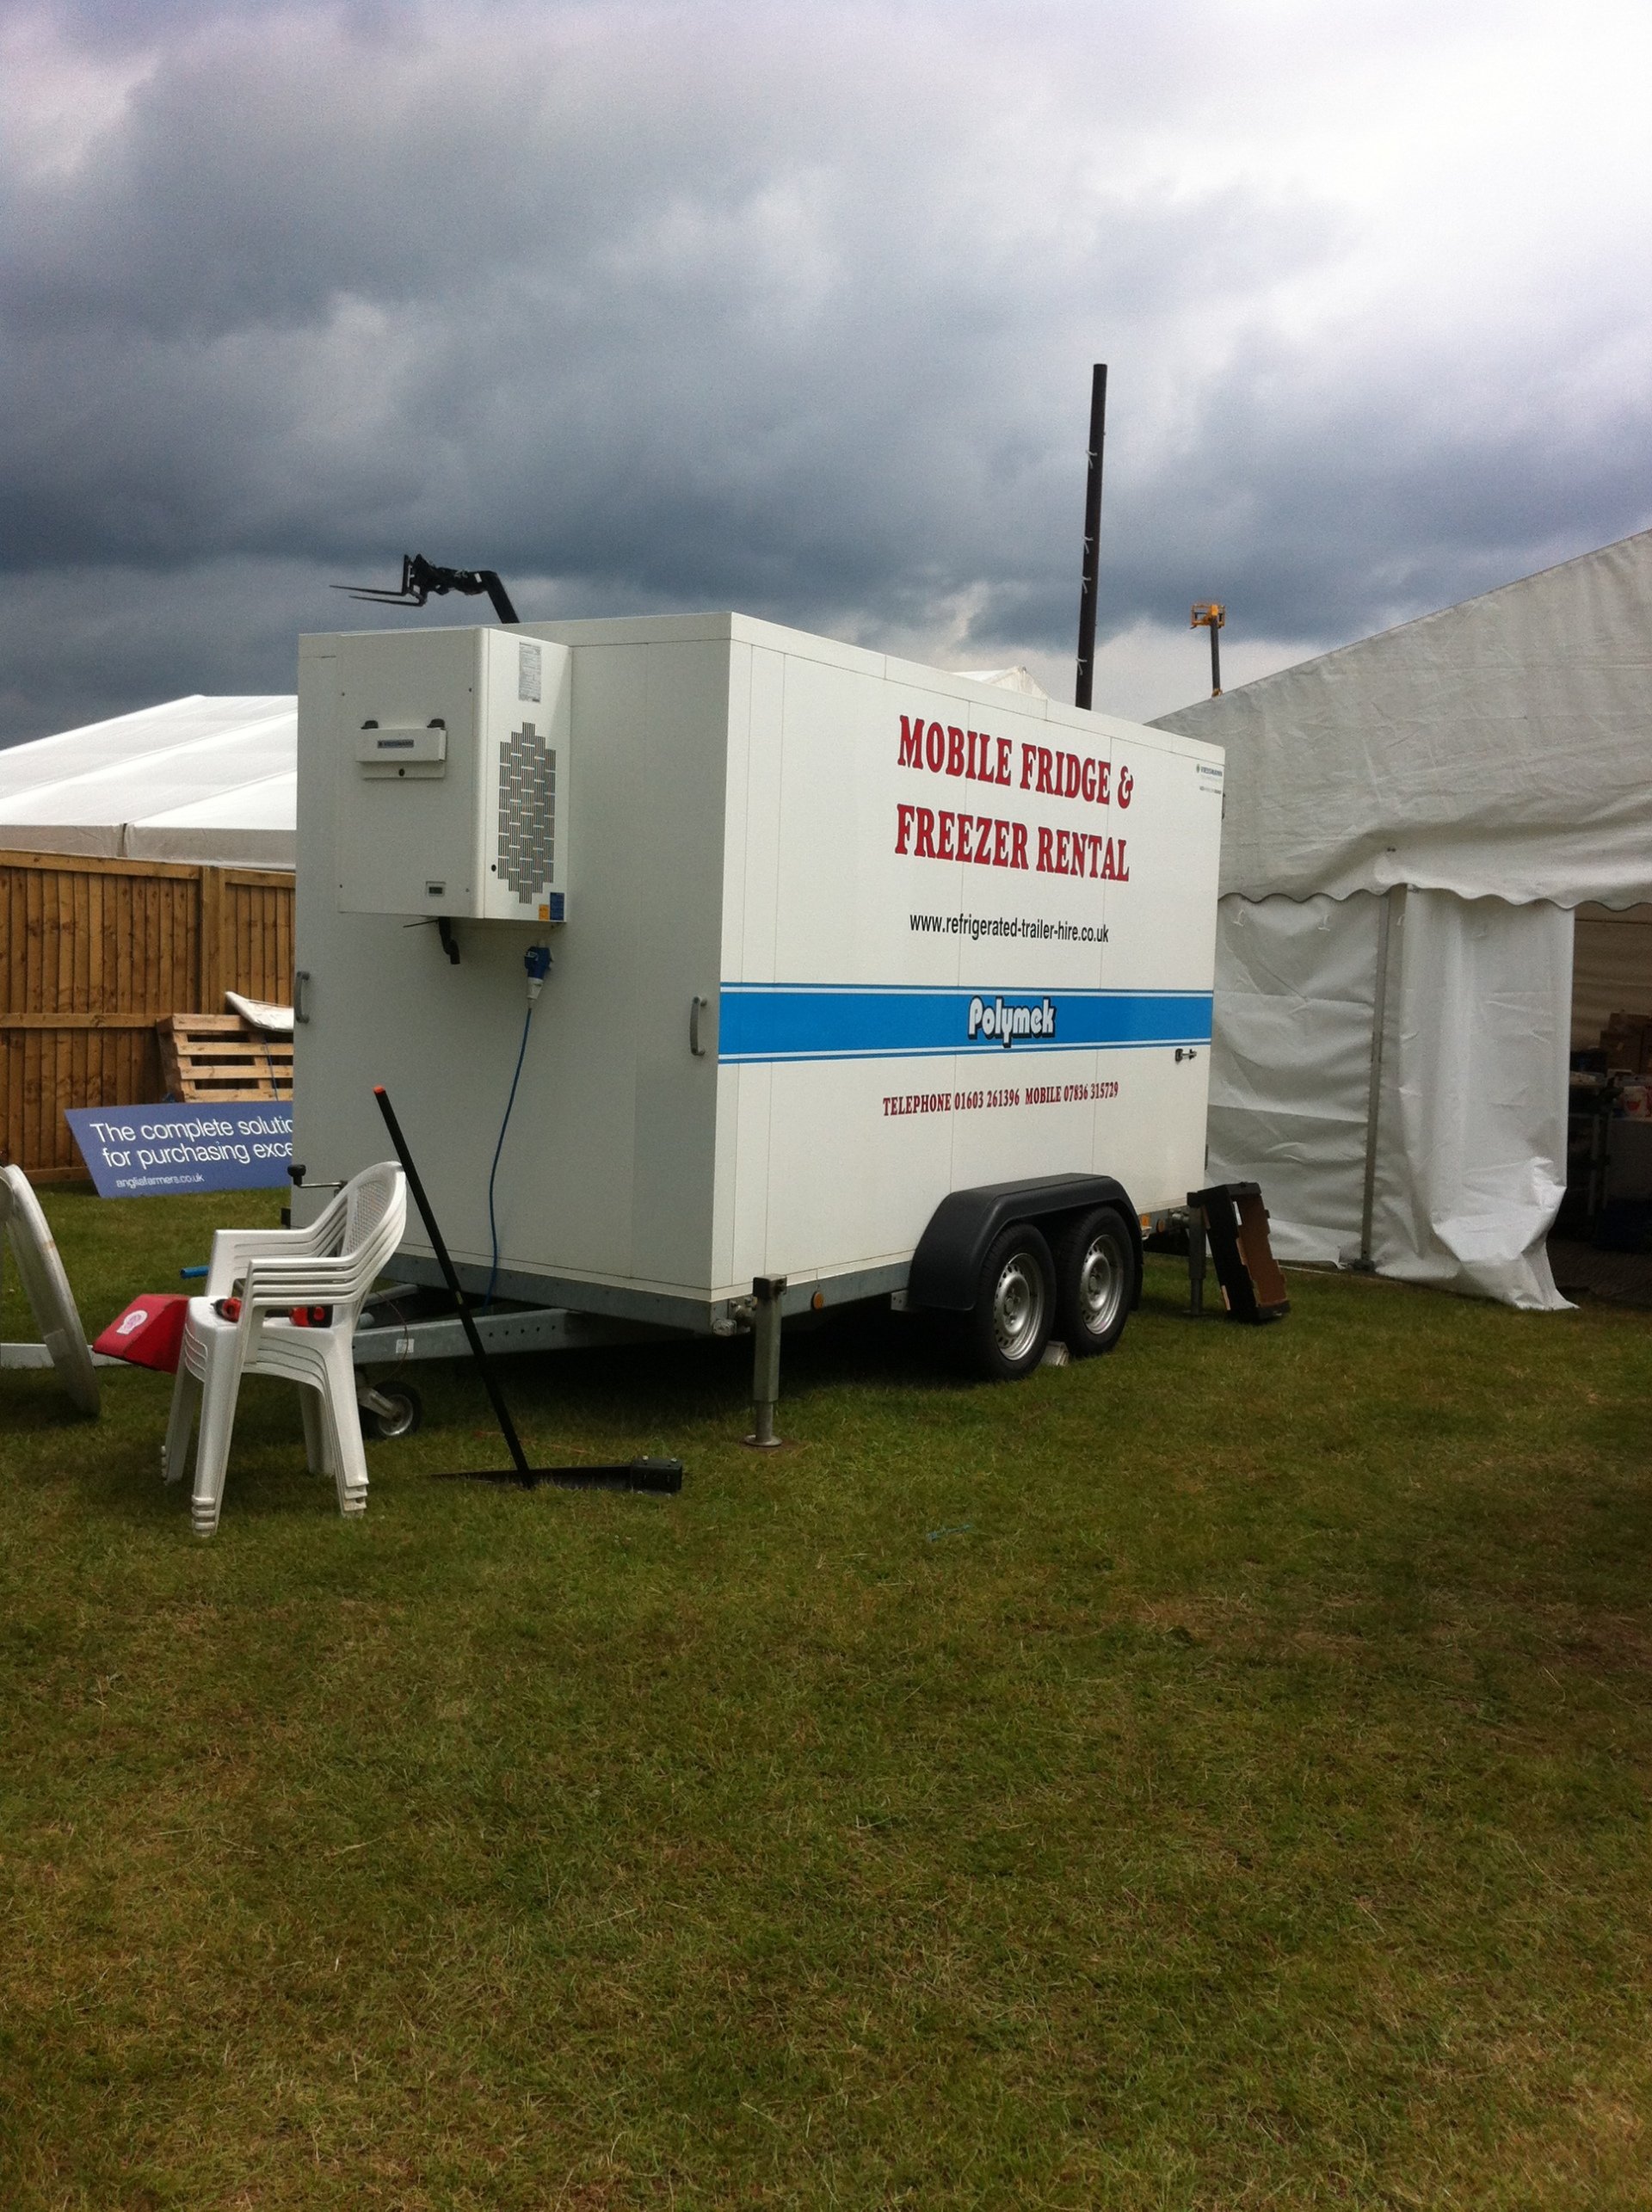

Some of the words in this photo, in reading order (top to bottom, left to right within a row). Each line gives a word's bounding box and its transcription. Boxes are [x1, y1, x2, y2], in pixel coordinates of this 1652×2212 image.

[897, 715, 1012, 787] MOBILE
[1020, 742, 1111, 804] FRIDGE
[1118, 766, 1134, 809] &
[895, 804, 1029, 870] FREEZER
[1036, 827, 1130, 882] RENTAL
[909, 913, 1109, 942] www.refrigerated-trailer-hire.co.uk
[968, 995, 1057, 1048] Polymek
[883, 1093, 952, 1116] TELEPHONE
[954, 1091, 983, 1110] 01603
[987, 1088, 1020, 1107] 261396
[1025, 1086, 1062, 1105] MOBILE
[1063, 1084, 1088, 1101] 07836
[1090, 1081, 1119, 1100] 315729
[89, 1123, 136, 1143] The
[140, 1118, 234, 1142] complete
[102, 1148, 133, 1168] for
[137, 1141, 250, 1171] purchasing
[115, 1173, 206, 1189] angliafarmers.co.uk
